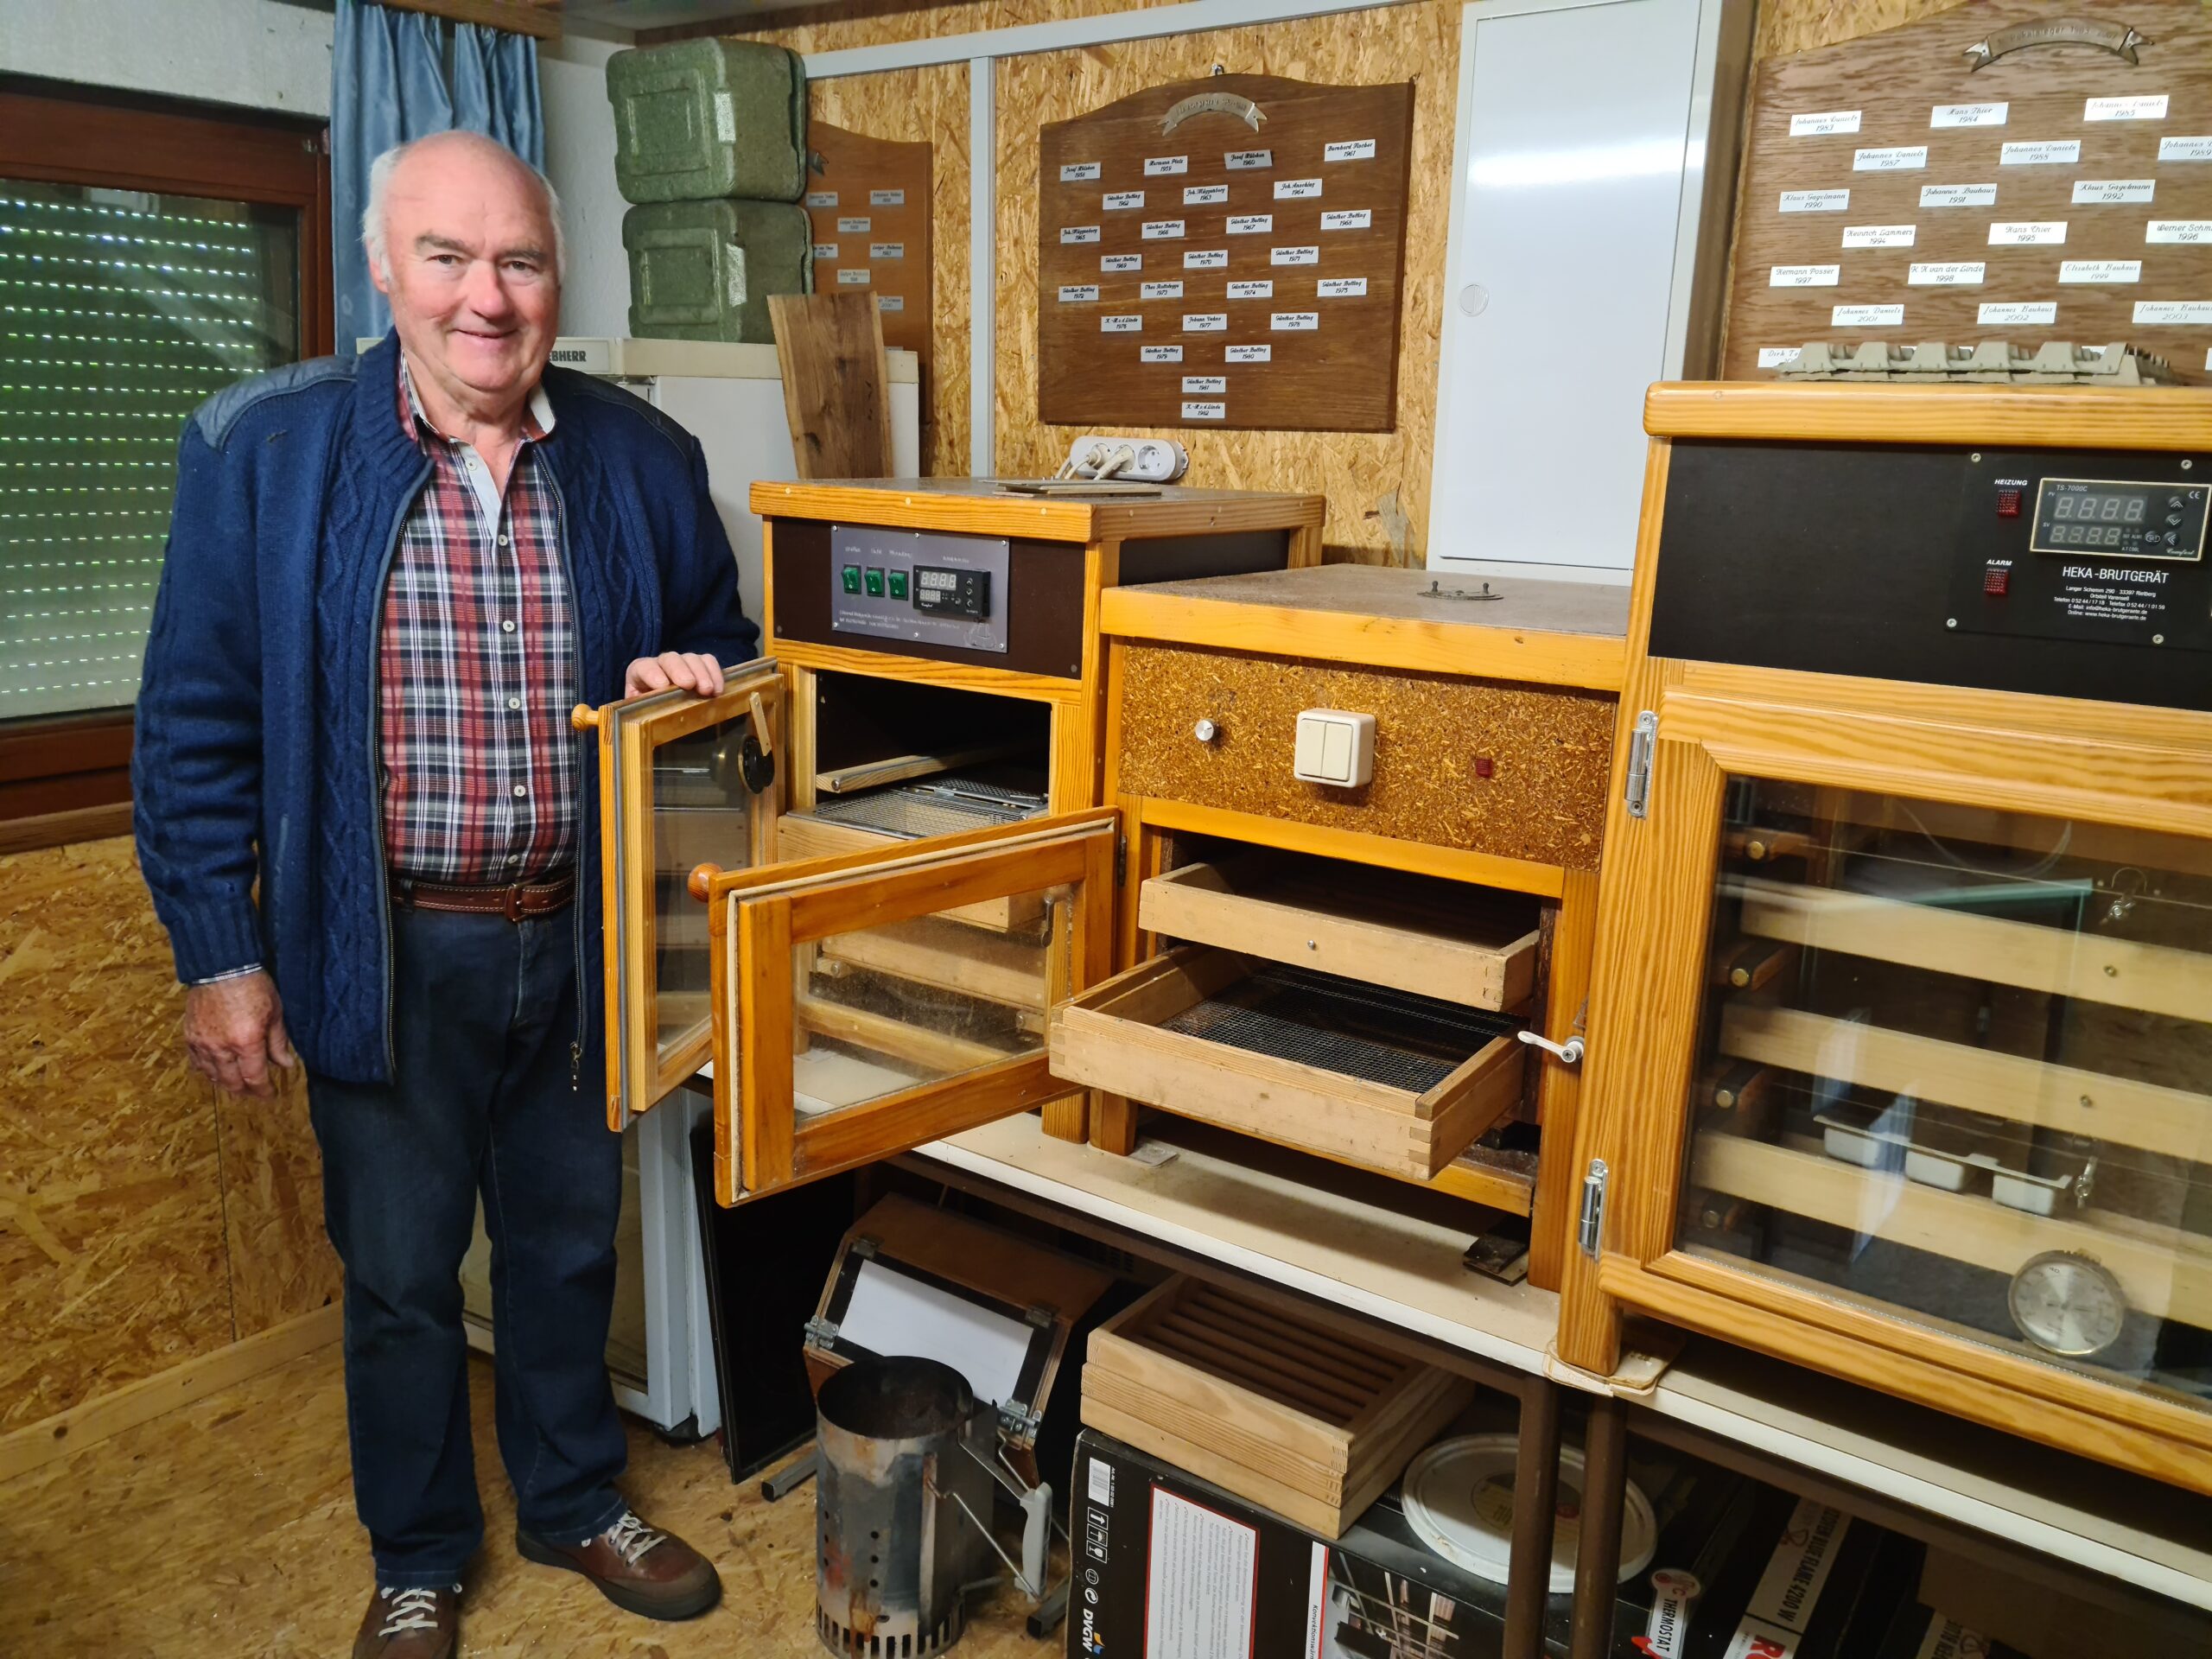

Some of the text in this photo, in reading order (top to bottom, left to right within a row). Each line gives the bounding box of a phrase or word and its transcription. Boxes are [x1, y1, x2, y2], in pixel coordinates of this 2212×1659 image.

[2005, 146, 2043, 155] Johannes
[1856, 153, 1892, 162] Johannes
[1847, 229, 1877, 238] Heinrich
[1837, 308, 1869, 316] Johannes
[1983, 306, 2016, 315] Johannes
[2139, 304, 2175, 314] Johannes
[550, 351, 587, 362] BHERR
[1782, 1584, 1807, 1609] 4200
[1656, 1599, 1678, 1651] THERMOSTAT
[1083, 1608, 1093, 1652] DVGW
